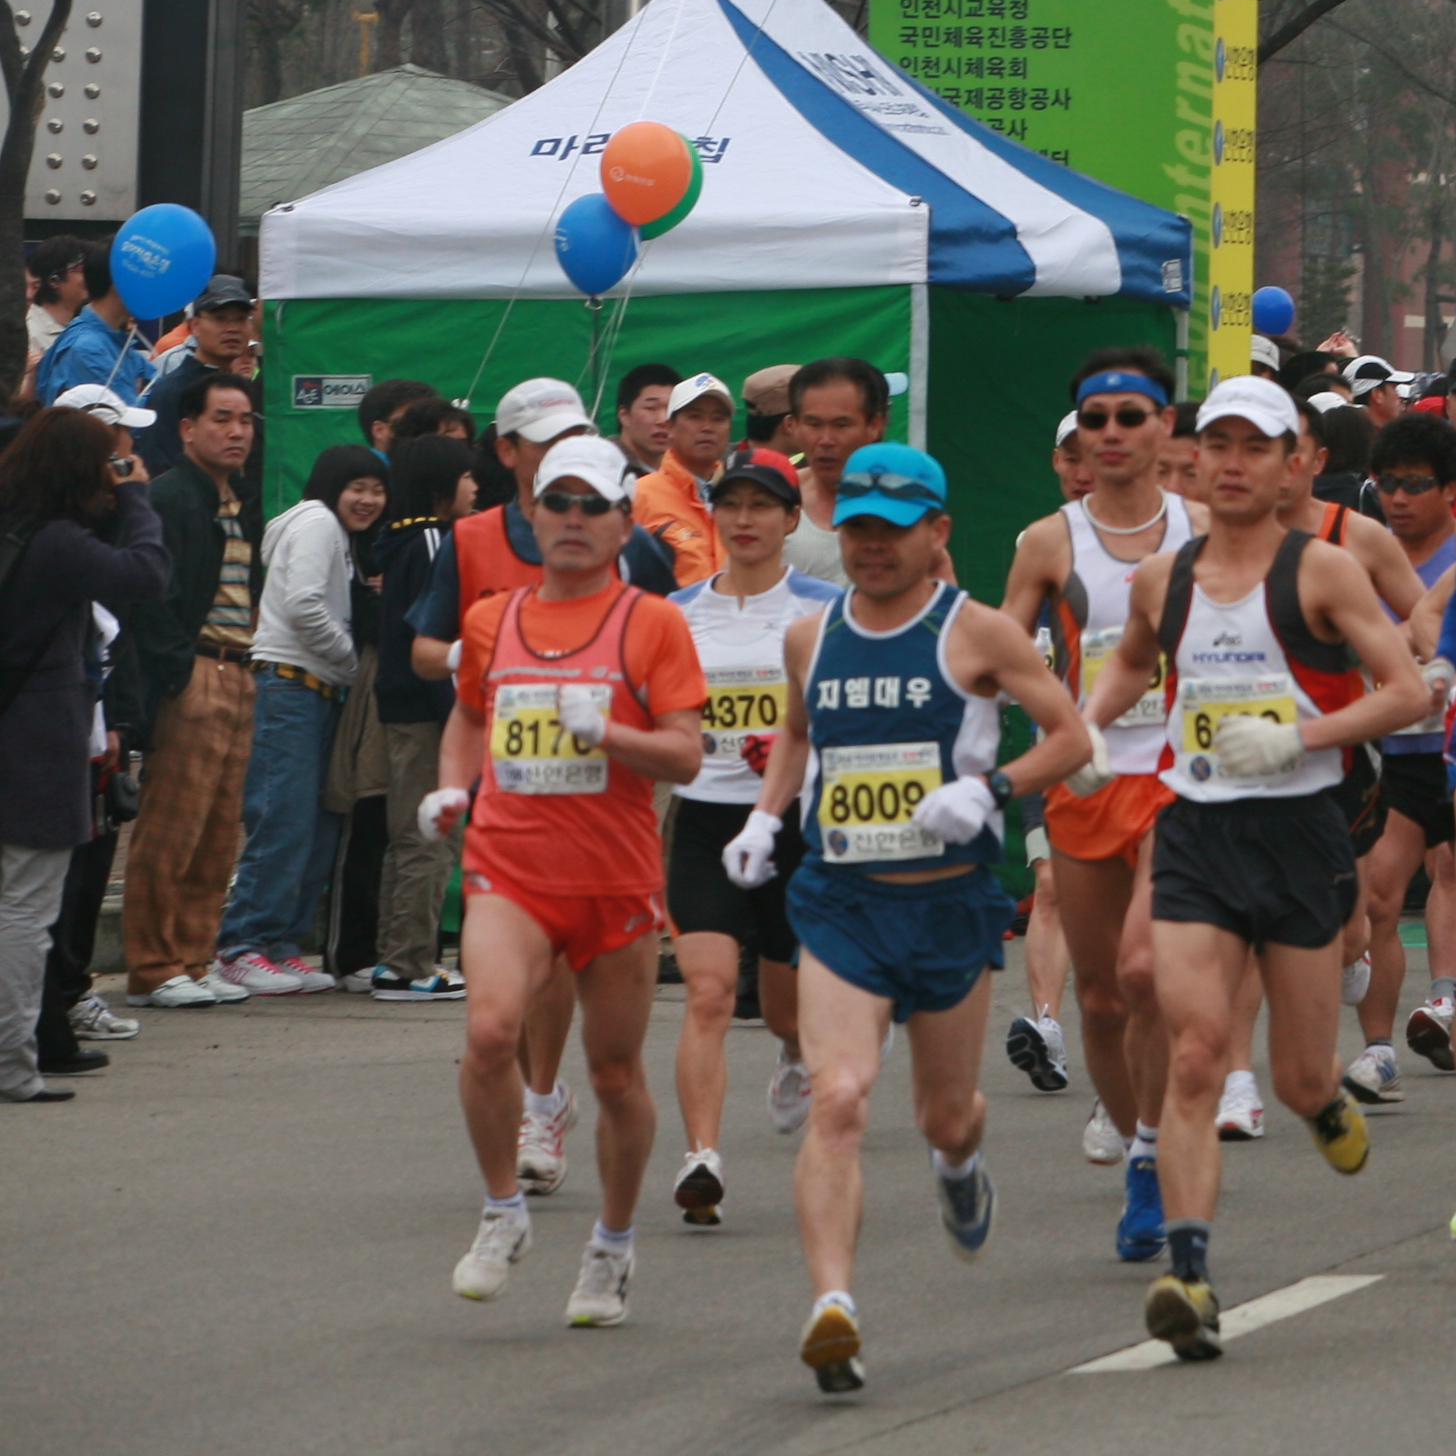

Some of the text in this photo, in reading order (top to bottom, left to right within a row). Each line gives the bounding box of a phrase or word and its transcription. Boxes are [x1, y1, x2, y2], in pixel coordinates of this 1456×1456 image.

[898, 24, 1073, 50] 국민체육진흥공단
[900, 55, 1028, 79] 인천시체육회
[928, 86, 1072, 111] 국제공항공사
[1192, 651, 1268, 664] HYUNDAI
[816, 676, 933, 711] 지엠대우
[702, 693, 778, 728] 4370
[830, 781, 925, 824] 8009
